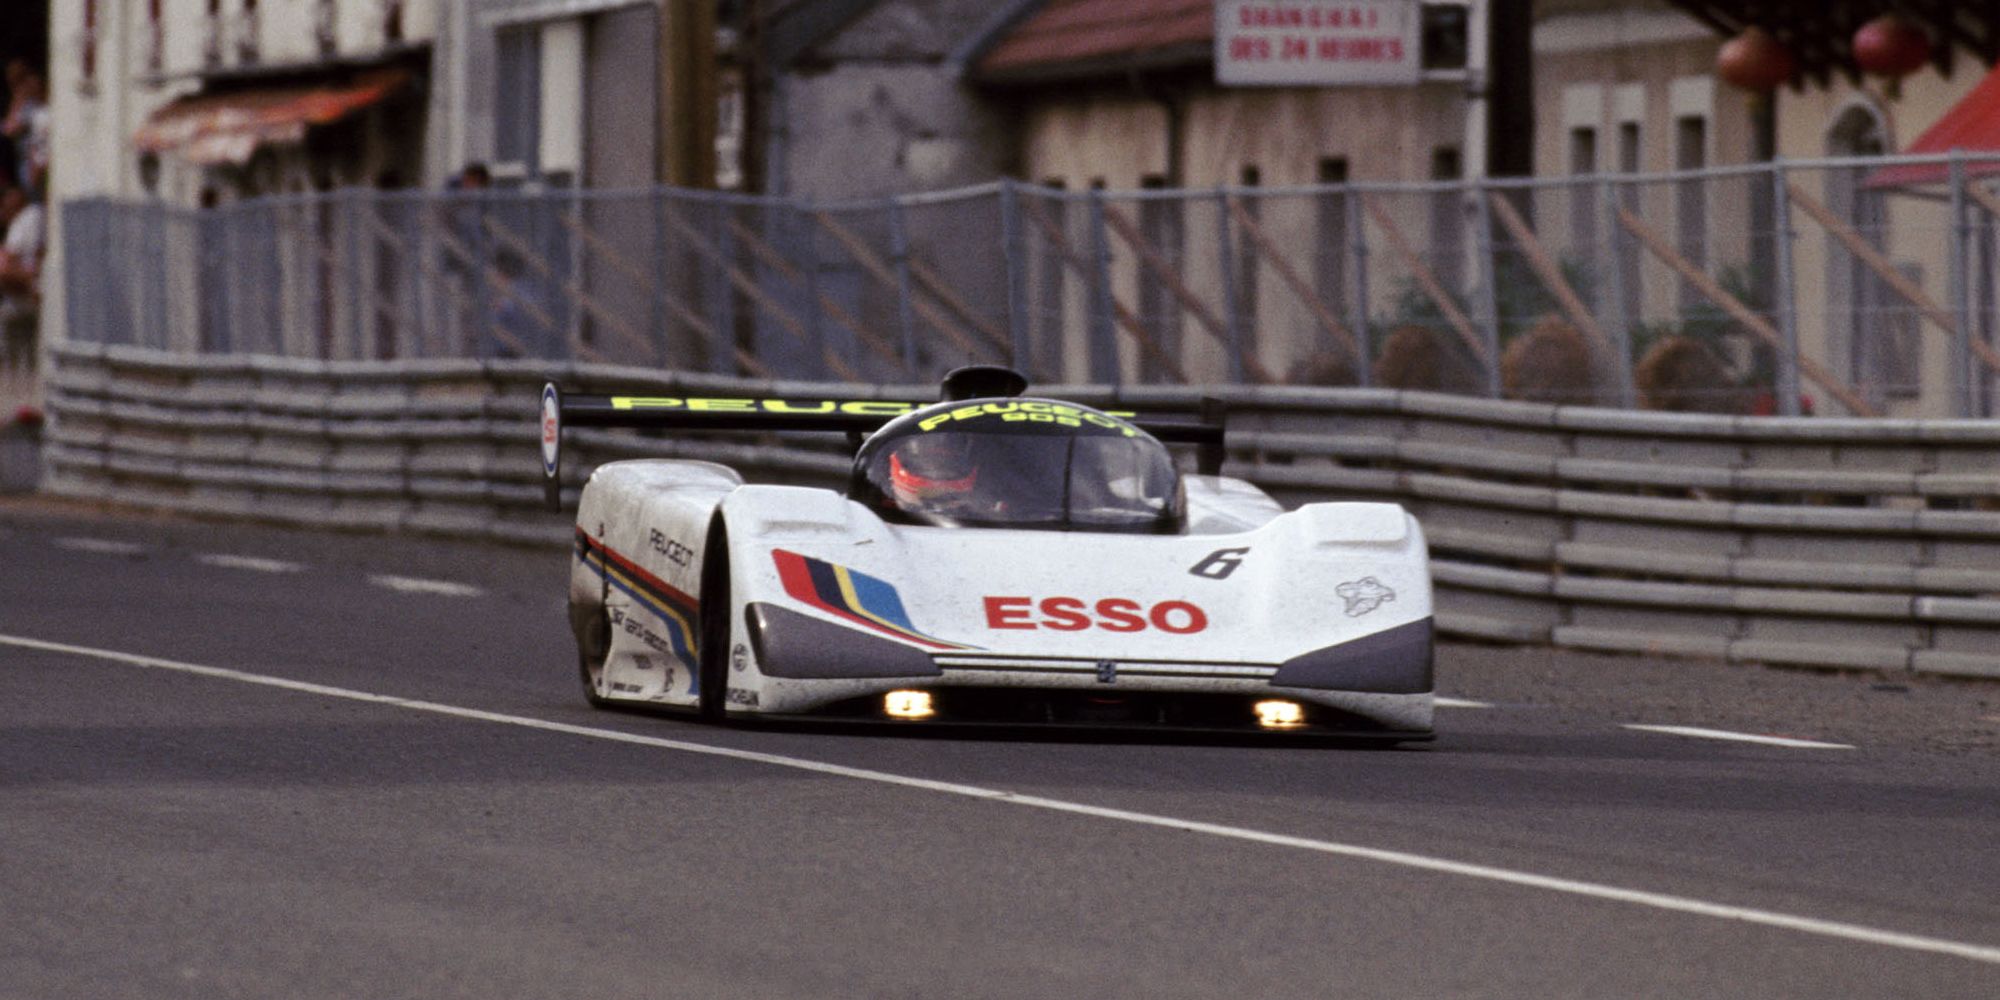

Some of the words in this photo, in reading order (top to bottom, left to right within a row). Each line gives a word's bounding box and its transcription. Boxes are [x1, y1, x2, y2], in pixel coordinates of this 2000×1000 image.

[611, 396, 1136, 416] PEUG
[917, 401, 1137, 438] PEUGEOT
[1002, 412, 1082, 427] 905
[1188, 546, 1251, 580] 6
[982, 596, 1208, 634] ESSO
